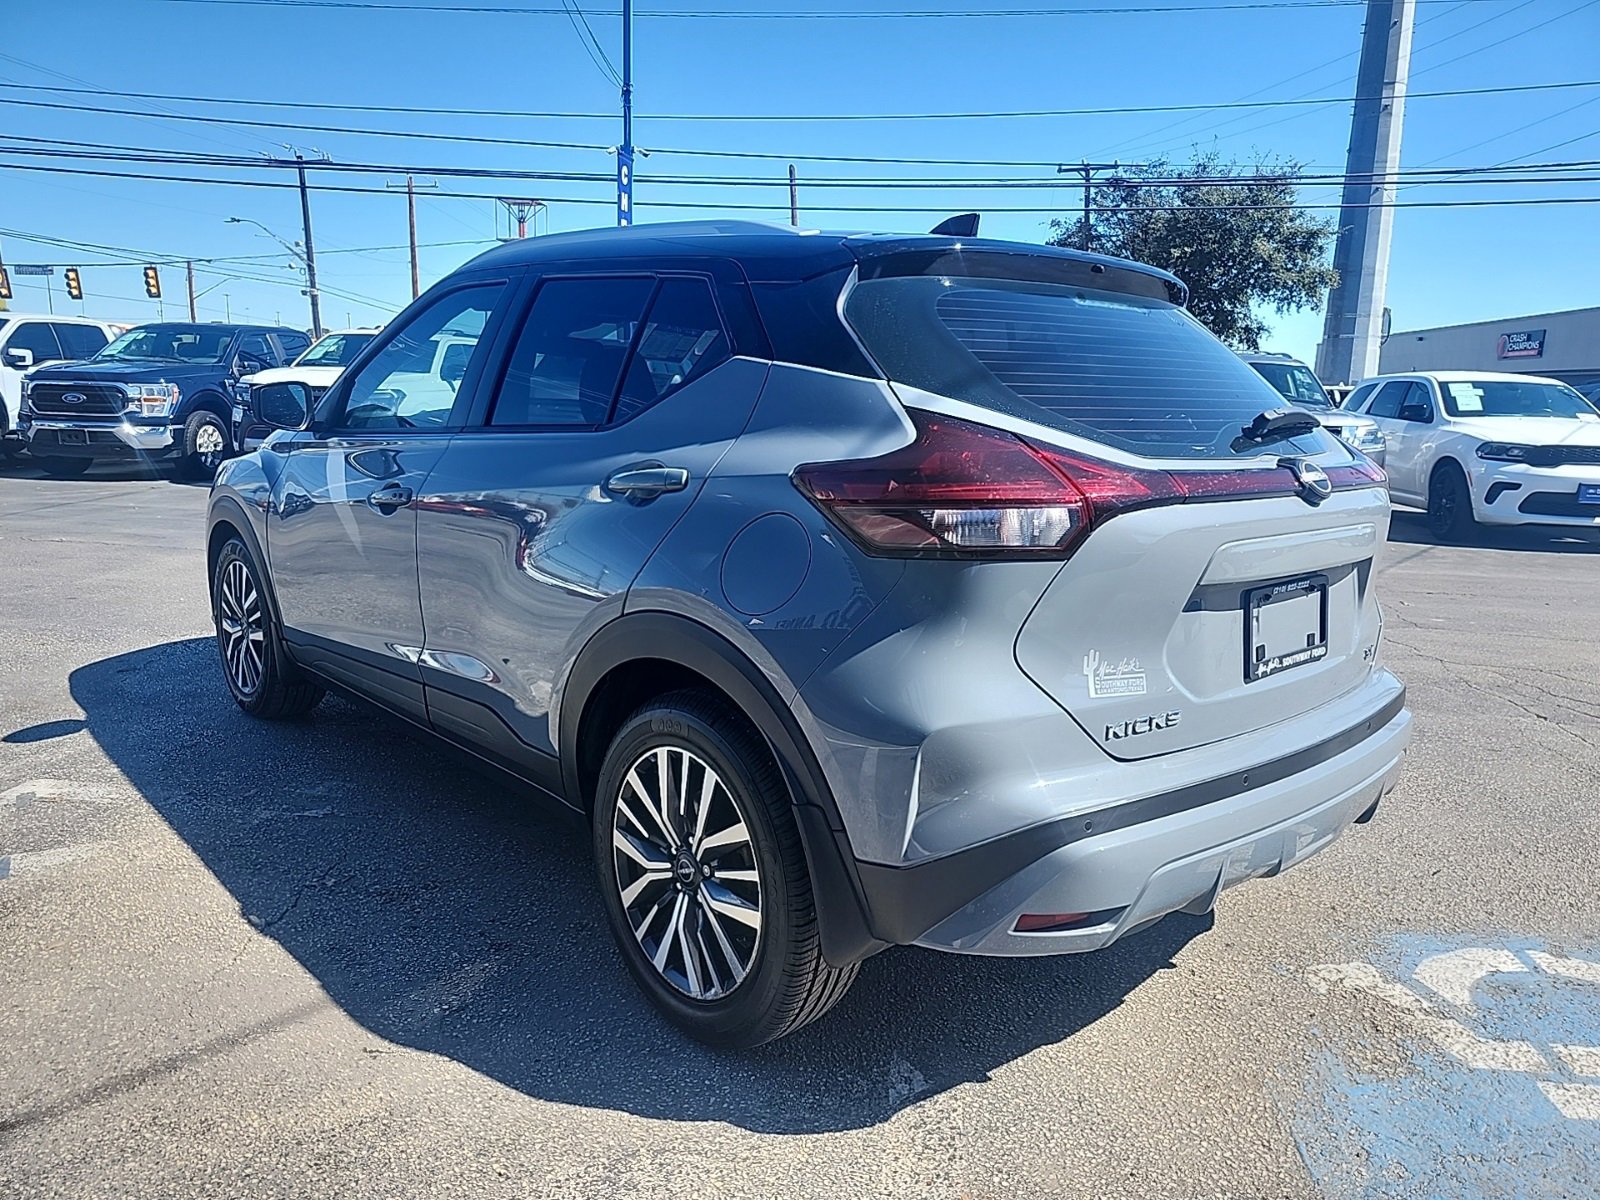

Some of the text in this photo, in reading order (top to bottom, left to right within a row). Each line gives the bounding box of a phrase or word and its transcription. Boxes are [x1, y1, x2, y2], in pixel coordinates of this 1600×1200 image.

[1510, 333, 1528, 343] CRASH
[1508, 340, 1540, 351] CHAMPIONS
[1311, 646, 1326, 658] FORD
[1095, 677, 1144, 689] SOUTHWAY FORD
[1104, 709, 1181, 742] KICKS
